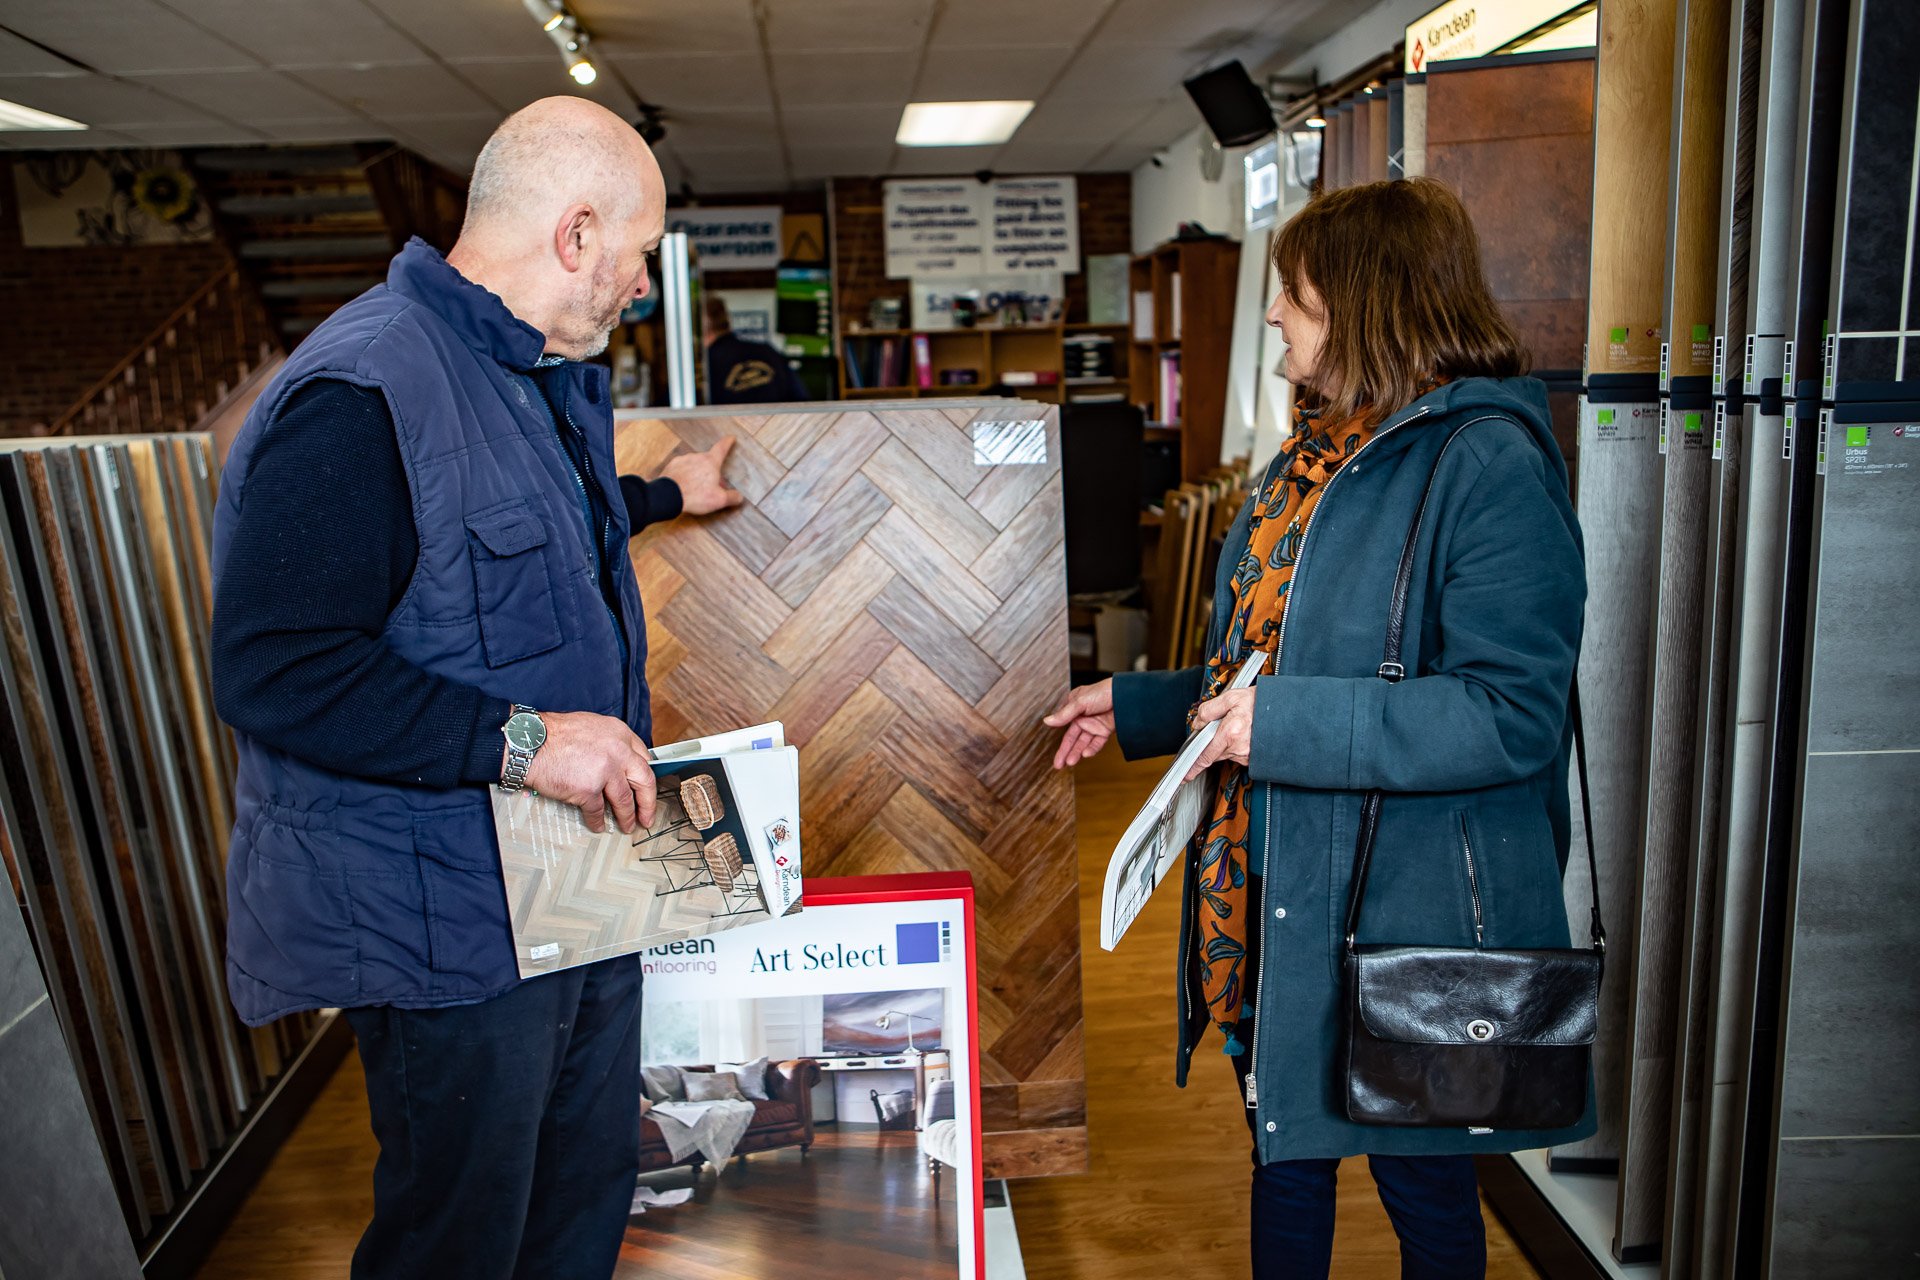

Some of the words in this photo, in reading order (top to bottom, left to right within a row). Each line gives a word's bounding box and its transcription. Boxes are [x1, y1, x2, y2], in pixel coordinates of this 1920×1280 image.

[897, 205, 944, 216] Payment
[1845, 456, 1866, 464] SP213
[782, 868, 791, 907] Karndean
[750, 947, 794, 973] Art
[803, 943, 889, 971] Select
[643, 960, 717, 975] nflooring
